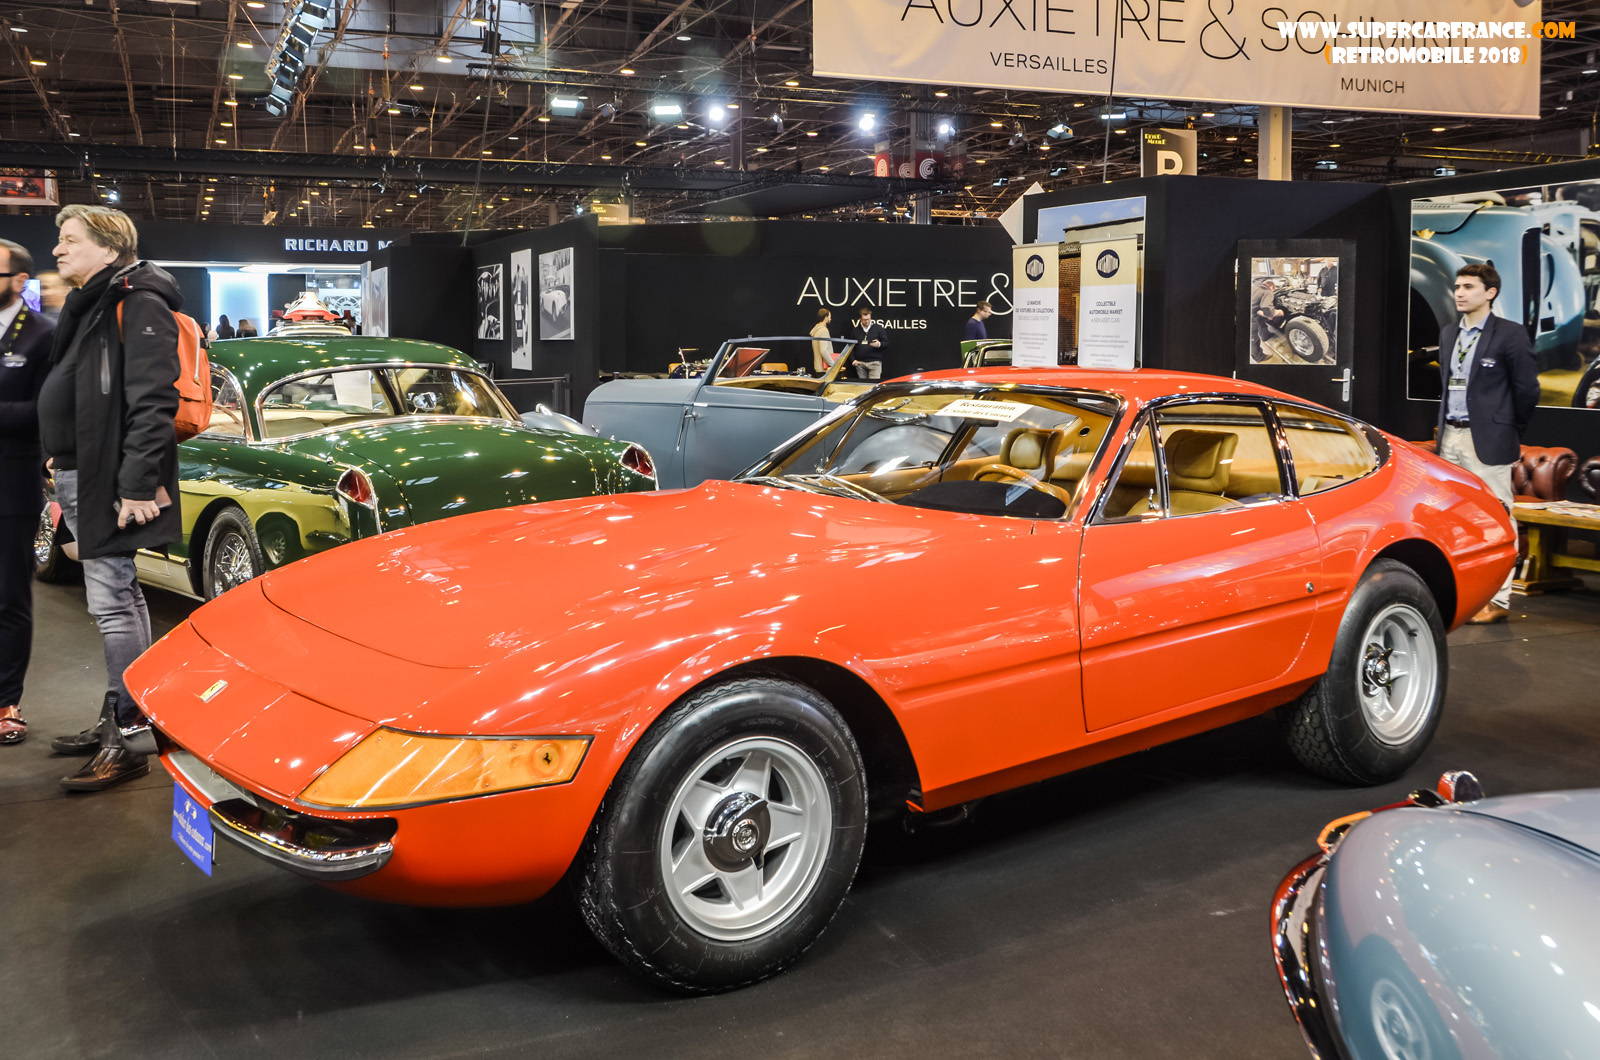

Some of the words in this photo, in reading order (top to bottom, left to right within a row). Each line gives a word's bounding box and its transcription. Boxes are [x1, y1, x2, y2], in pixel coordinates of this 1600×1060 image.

[990, 52, 1108, 74] VERSAILLES
[1341, 77, 1405, 94] MUNICH
[284, 238, 369, 252] RICHARD
[797, 276, 978, 307] AUXIETRE
[986, 272, 1013, 315] &
[851, 319, 927, 329] VSAILLES
